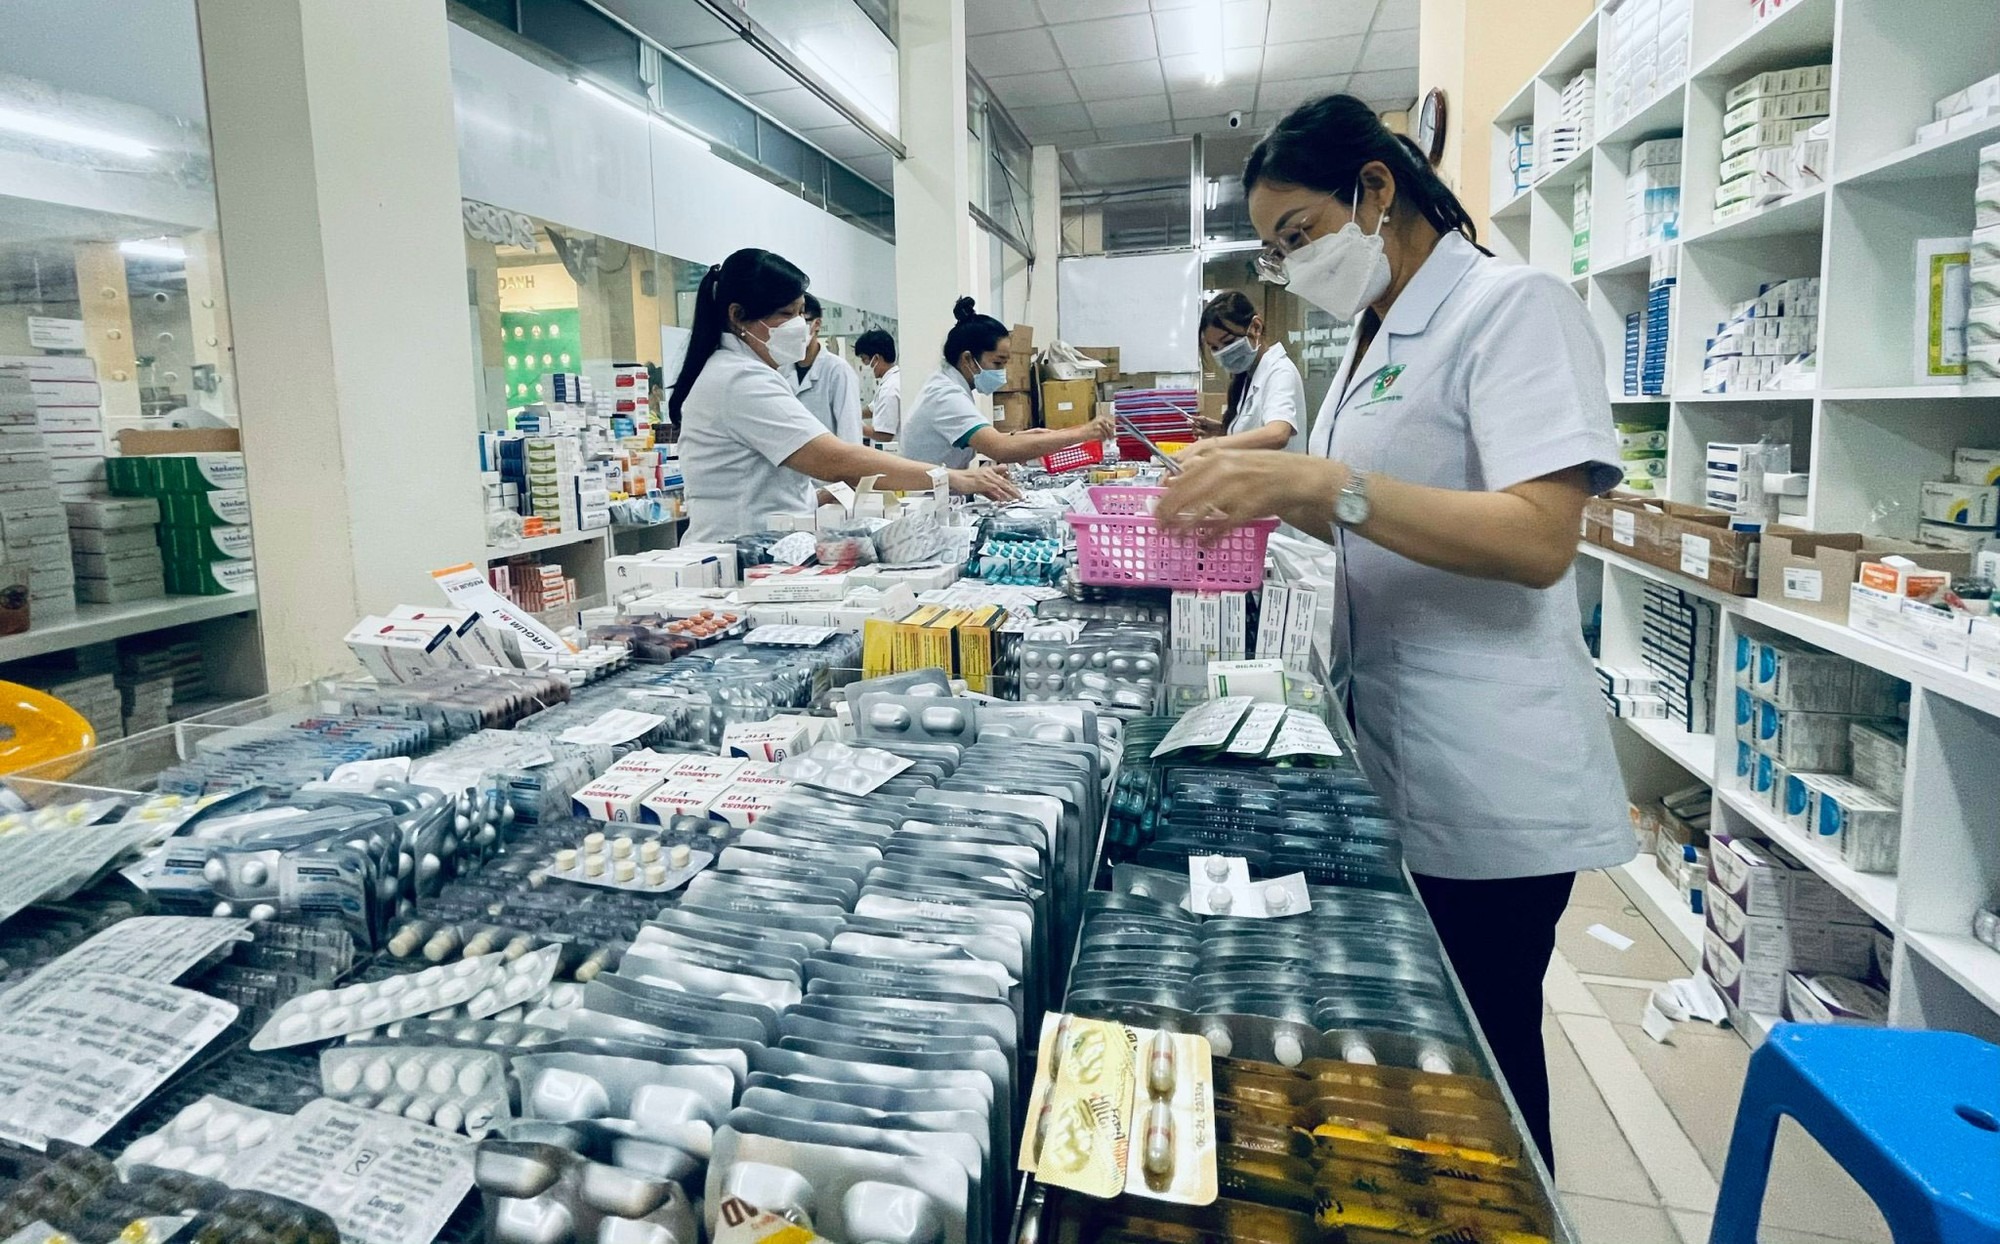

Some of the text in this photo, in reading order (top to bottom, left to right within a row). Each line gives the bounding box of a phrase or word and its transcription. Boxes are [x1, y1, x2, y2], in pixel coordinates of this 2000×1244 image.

[736, 777, 786, 785] ALANBOSS
[582, 790, 633, 799] ALANBOSS
[652, 796, 703, 806] ALANBOSS
